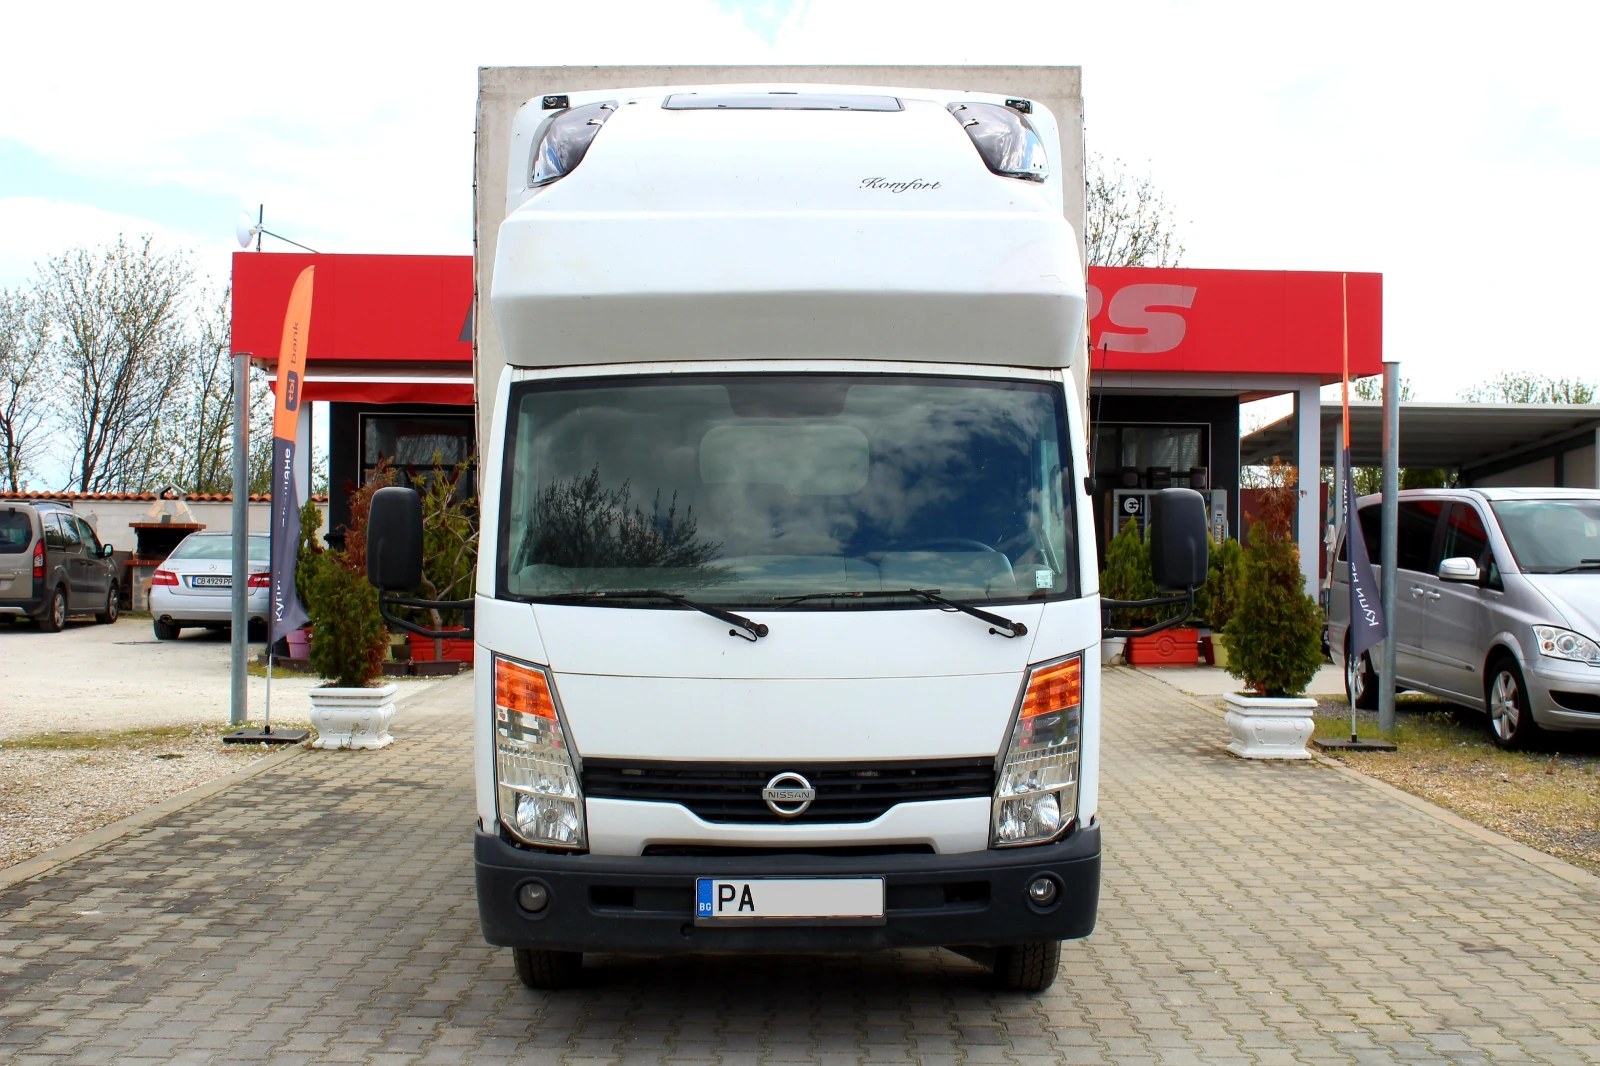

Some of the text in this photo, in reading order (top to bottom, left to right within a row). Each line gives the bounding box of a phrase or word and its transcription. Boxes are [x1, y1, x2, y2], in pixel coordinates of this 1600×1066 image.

[860, 177, 941, 193] Komfort
[1088, 284, 1197, 353] S
[290, 322, 299, 364] bank
[768, 791, 810, 799] NISSAN
[699, 884, 755, 912] BG PA
